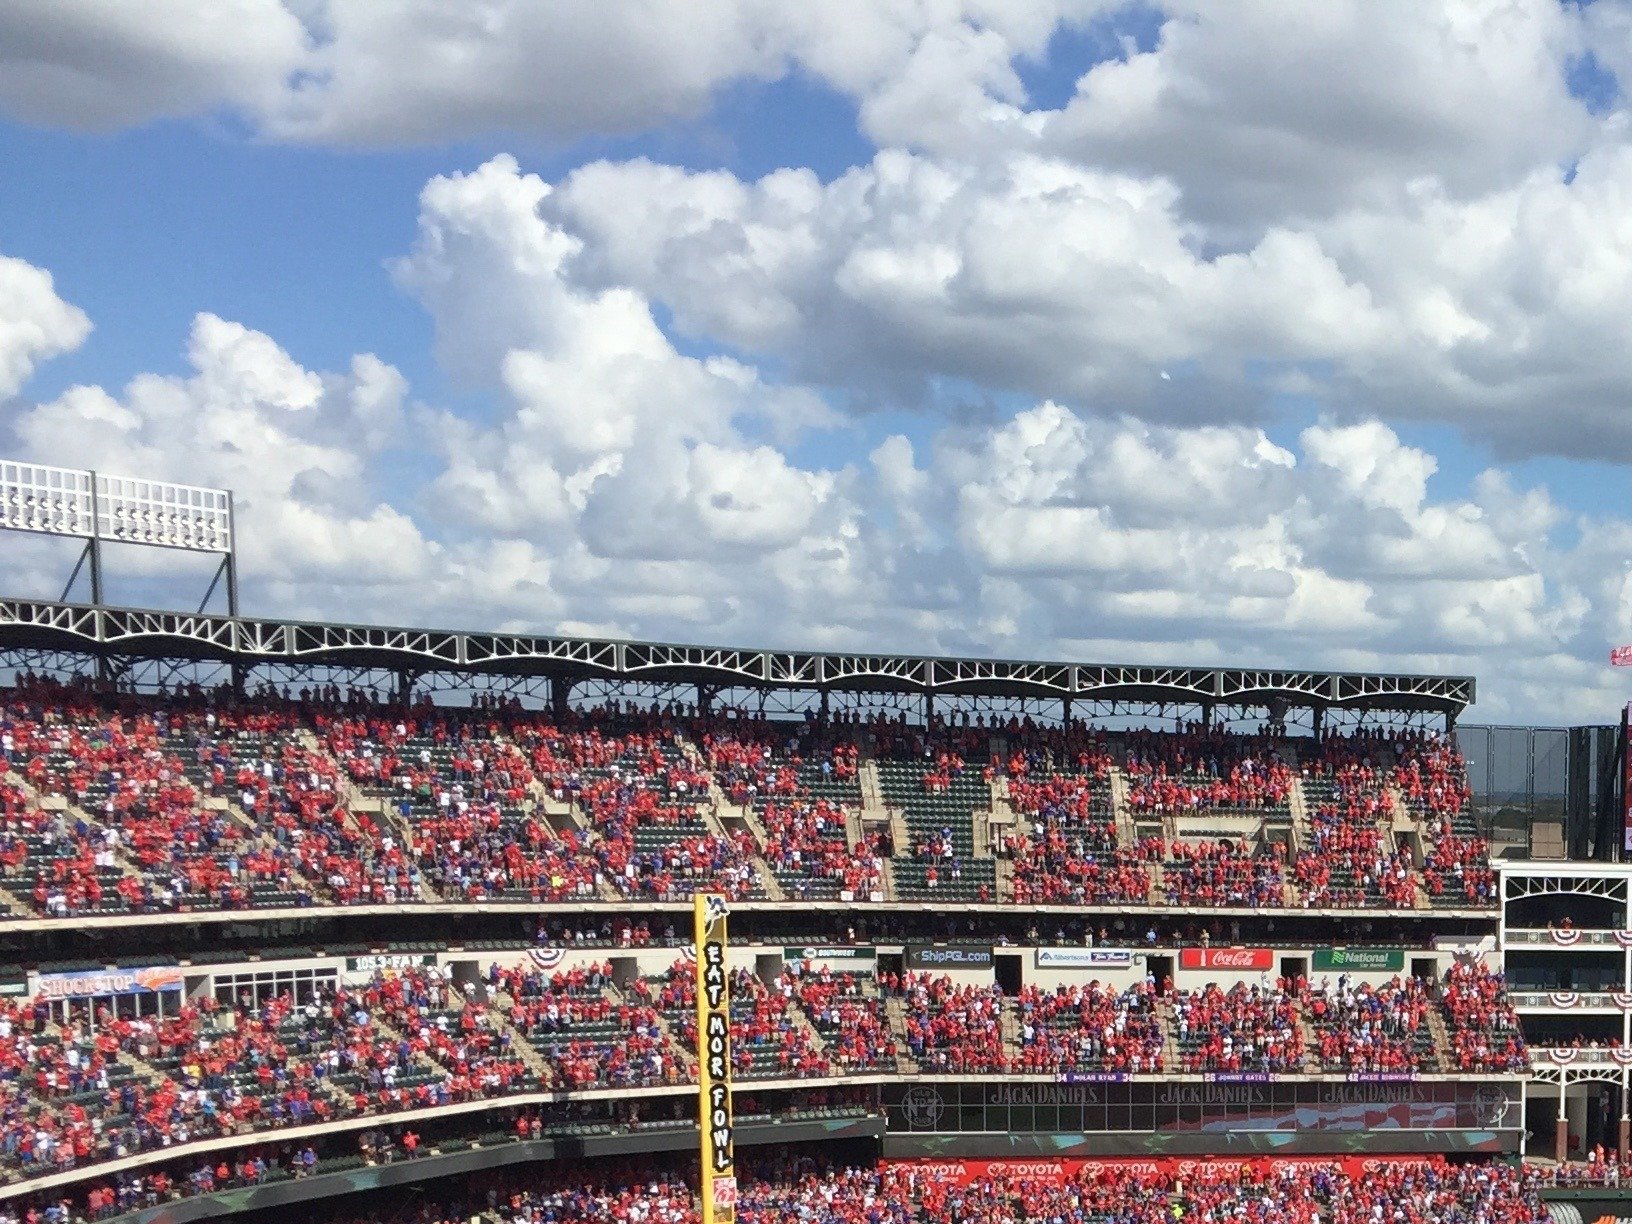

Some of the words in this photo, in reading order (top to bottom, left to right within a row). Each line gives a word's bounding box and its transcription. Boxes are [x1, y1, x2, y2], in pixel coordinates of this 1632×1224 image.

[1212, 950, 1254, 966] Coca-Cola
[1344, 952, 1389, 963] National
[707, 946, 721, 1005] EAT
[709, 1016, 725, 1076] MOR
[991, 1084, 1032, 1105] JACK
[1160, 1084, 1200, 1103] JACK
[1324, 1084, 1362, 1103] JACK
[711, 1088, 730, 1169] FOWL
[912, 1164, 967, 1176] TOYOTA
[1199, 1161, 1246, 1173] TOYOT
